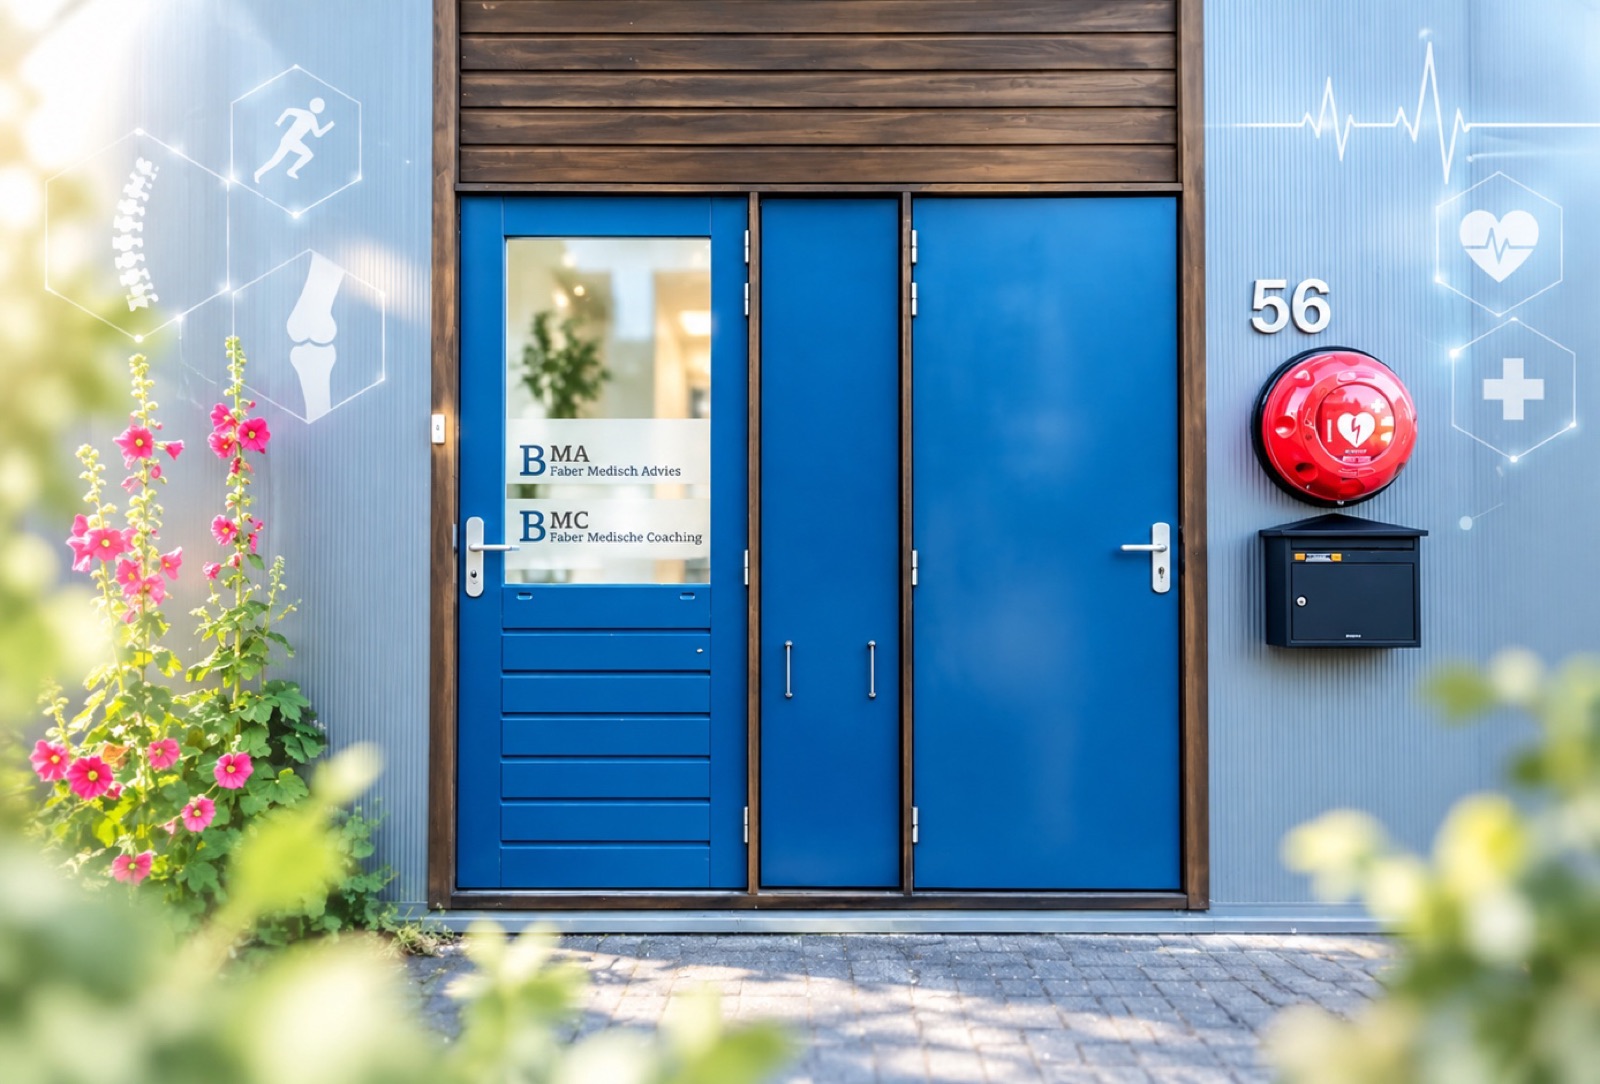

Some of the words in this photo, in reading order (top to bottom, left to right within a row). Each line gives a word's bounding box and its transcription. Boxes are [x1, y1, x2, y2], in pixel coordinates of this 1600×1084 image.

[1250, 278, 1331, 333] 56
[550, 466, 584, 477] Faber
[588, 466, 639, 477] Medisch
[641, 466, 681, 477] Advies
[550, 532, 584, 543] Faber
[588, 532, 644, 543] Medische
[646, 532, 703, 545] Coaching
